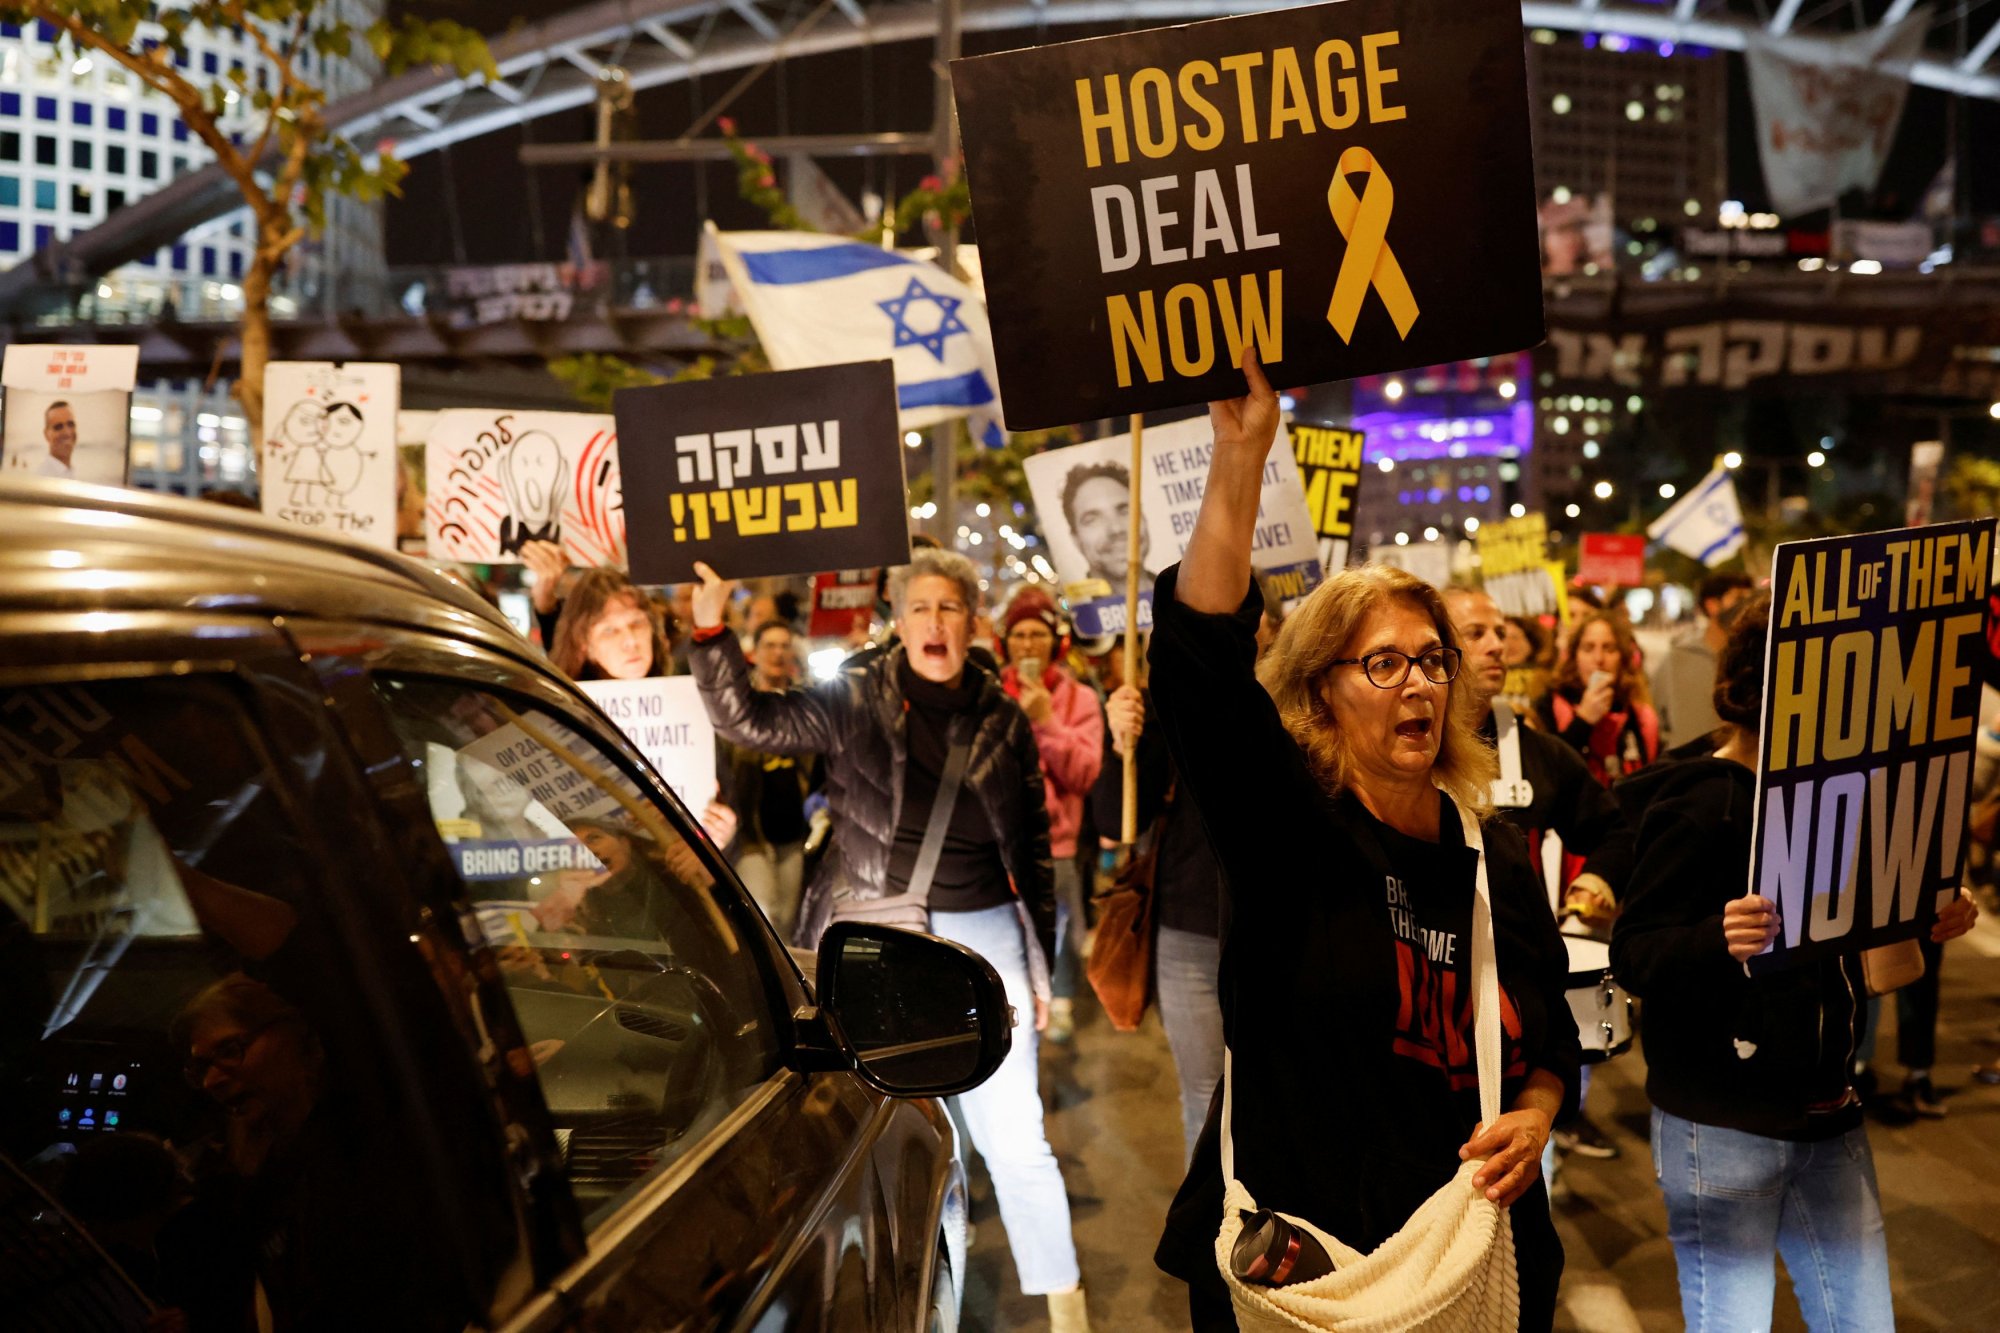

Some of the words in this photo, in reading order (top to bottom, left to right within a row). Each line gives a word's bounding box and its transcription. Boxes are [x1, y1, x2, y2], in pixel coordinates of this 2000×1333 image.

[1075, 31, 1407, 168] HOSTAGE
[1090, 163, 1281, 273] DEAL
[1106, 269, 1283, 388] NOW
[675, 420, 840, 489] עסקה
[1152, 450, 1179, 477] HE
[1294, 426, 1364, 470] THEM
[669, 478, 858, 542] עכשיו!
[1160, 476, 1203, 506] TIME
[1779, 547, 1861, 629] ALL
[1857, 561, 1885, 601] OF
[1886, 530, 1990, 614] THEM
[1097, 599, 1153, 632] BRIG
[637, 695, 663, 717] NO
[1769, 613, 1983, 772] HOME
[644, 724, 695, 747] WAIT.
[462, 847, 520, 876] BRING
[575, 843, 602, 870] HO
[1758, 750, 1970, 953] NOW!
